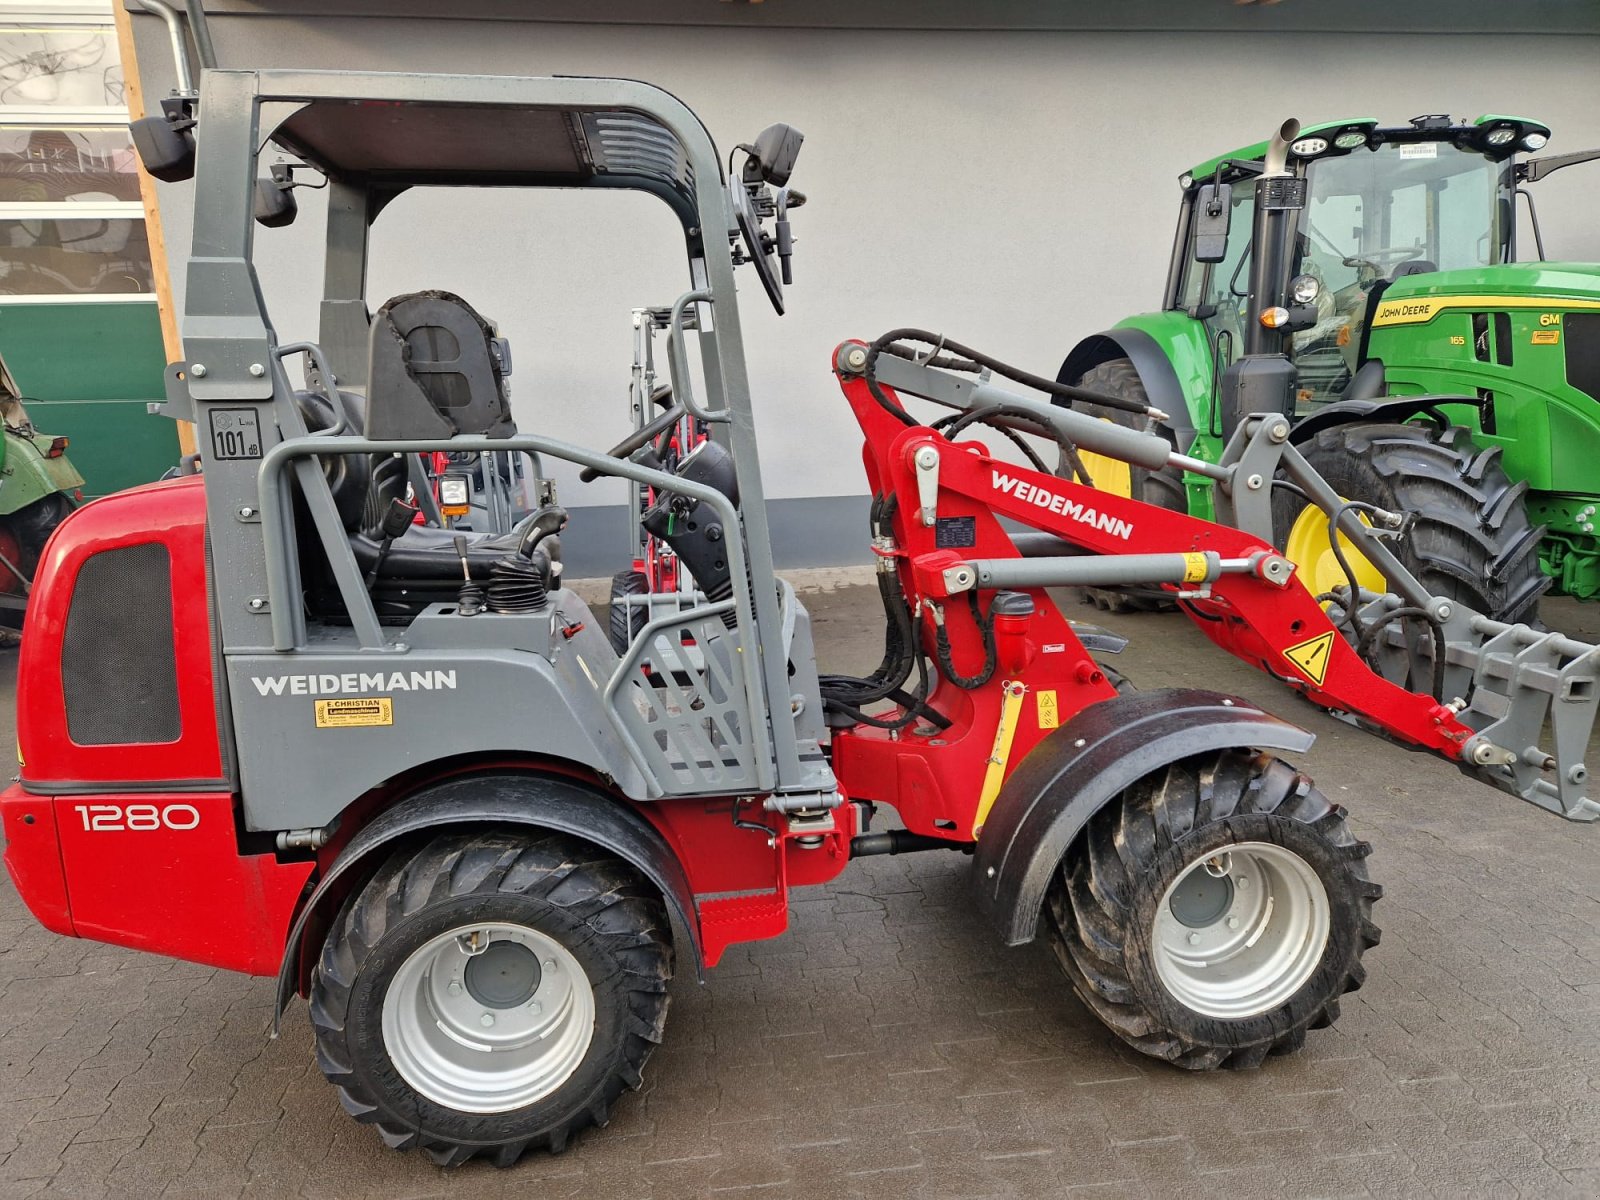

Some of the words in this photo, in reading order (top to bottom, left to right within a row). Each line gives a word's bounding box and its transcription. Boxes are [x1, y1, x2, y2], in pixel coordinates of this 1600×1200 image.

[1380, 307, 1401, 318] JOHN
[1402, 304, 1431, 315] DEERE
[1540, 314, 1560, 326] 6M
[1450, 336, 1465, 345] 165
[217, 431, 246, 456] 101
[248, 443, 258, 455] dB
[992, 470, 1134, 540] WEIDEMANN
[251, 670, 457, 697] WEIDEMANN
[75, 804, 200, 831] 1280
